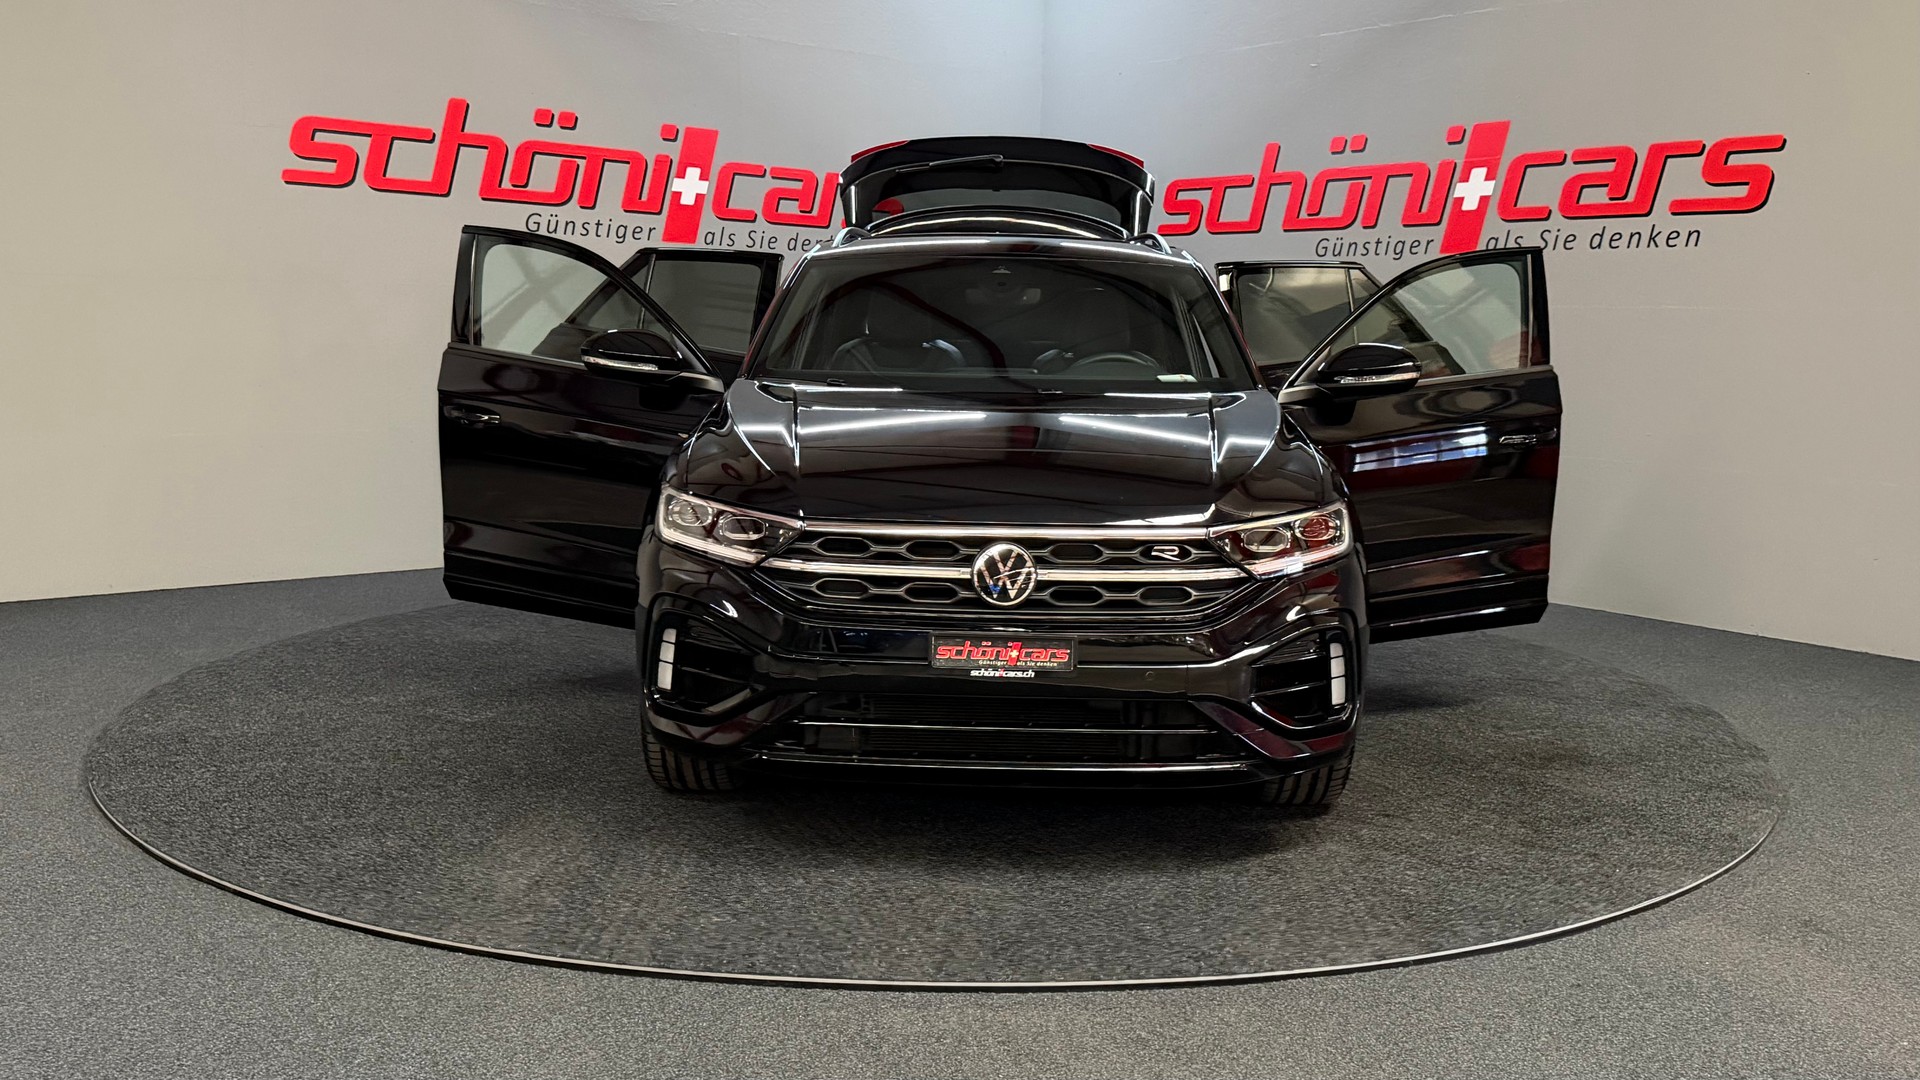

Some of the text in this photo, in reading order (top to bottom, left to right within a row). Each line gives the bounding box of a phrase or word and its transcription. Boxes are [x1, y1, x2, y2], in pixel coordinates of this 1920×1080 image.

[525, 212, 657, 244] Günstiger
[704, 226, 736, 247] als
[746, 229, 778, 250] Sie
[1315, 224, 1701, 260] Günstiger als Sie denken
